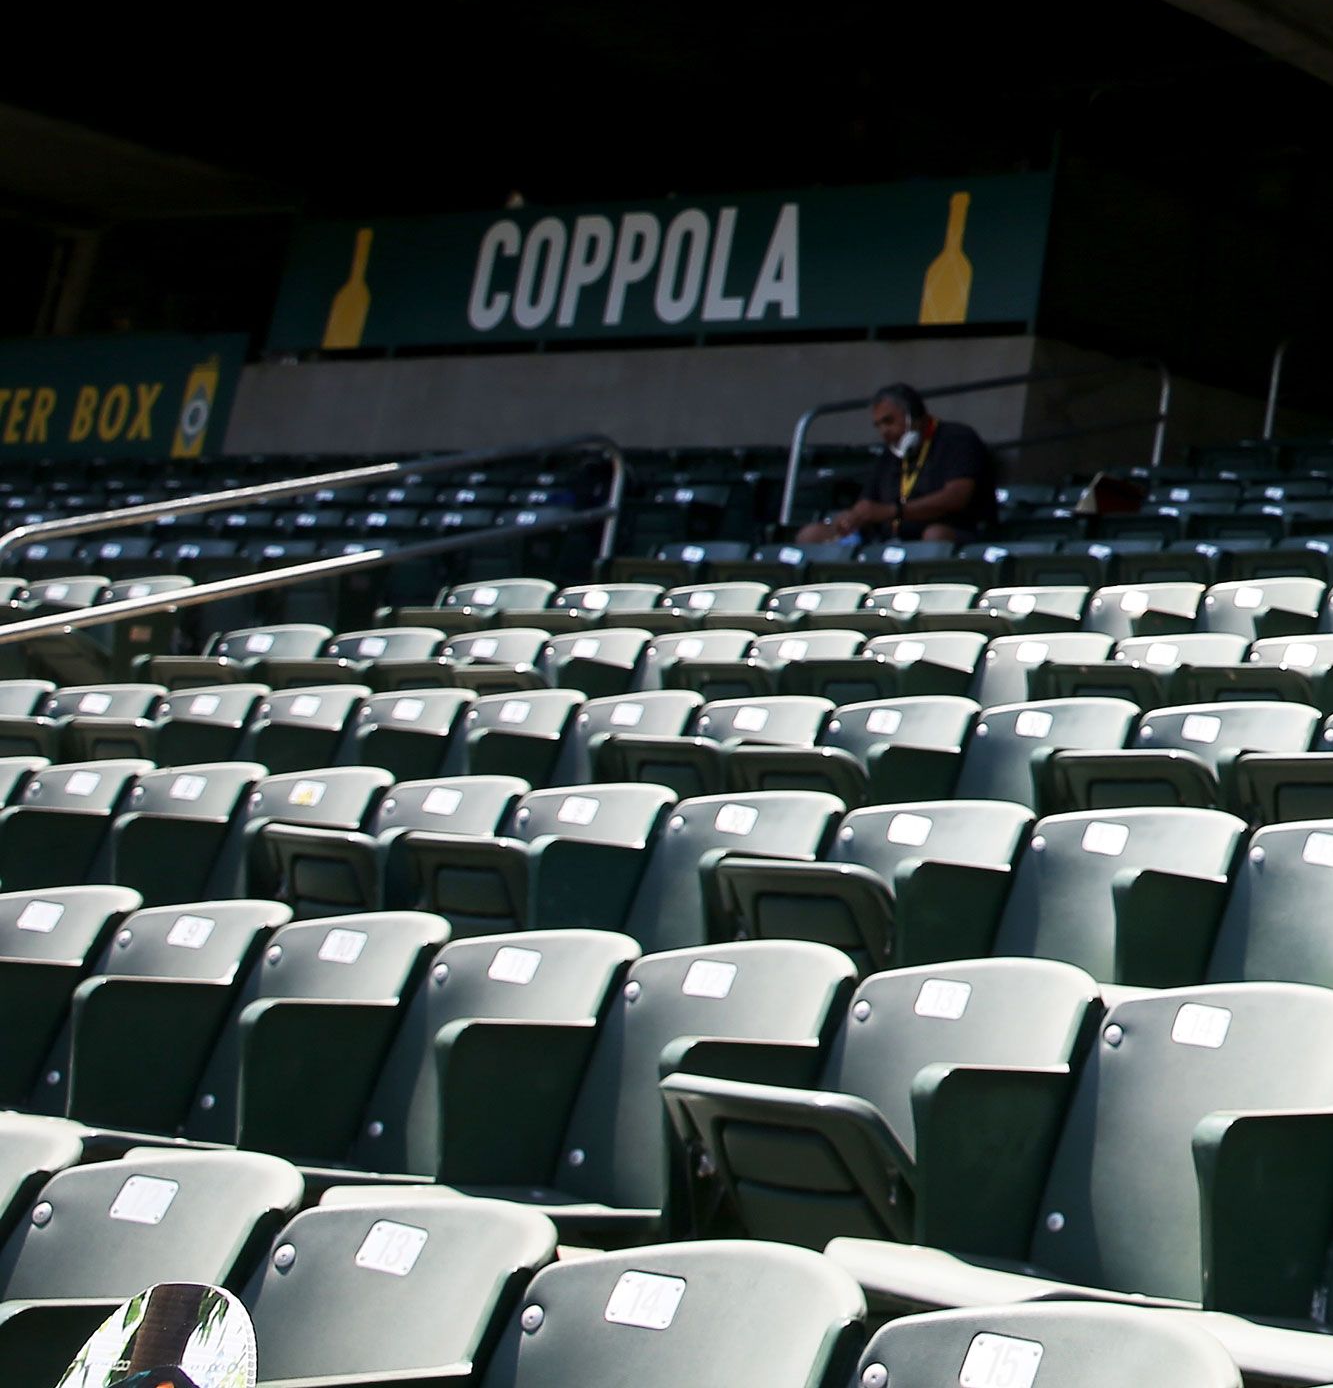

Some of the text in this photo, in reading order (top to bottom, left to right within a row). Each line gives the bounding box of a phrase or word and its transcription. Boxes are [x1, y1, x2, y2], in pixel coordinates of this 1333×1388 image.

[467, 203, 799, 331] COPPOLA
[69, 382, 163, 443] BOX
[377, 1229, 412, 1268] 13
[630, 1279, 665, 1322] 14
[985, 1342, 1020, 1387] 15
